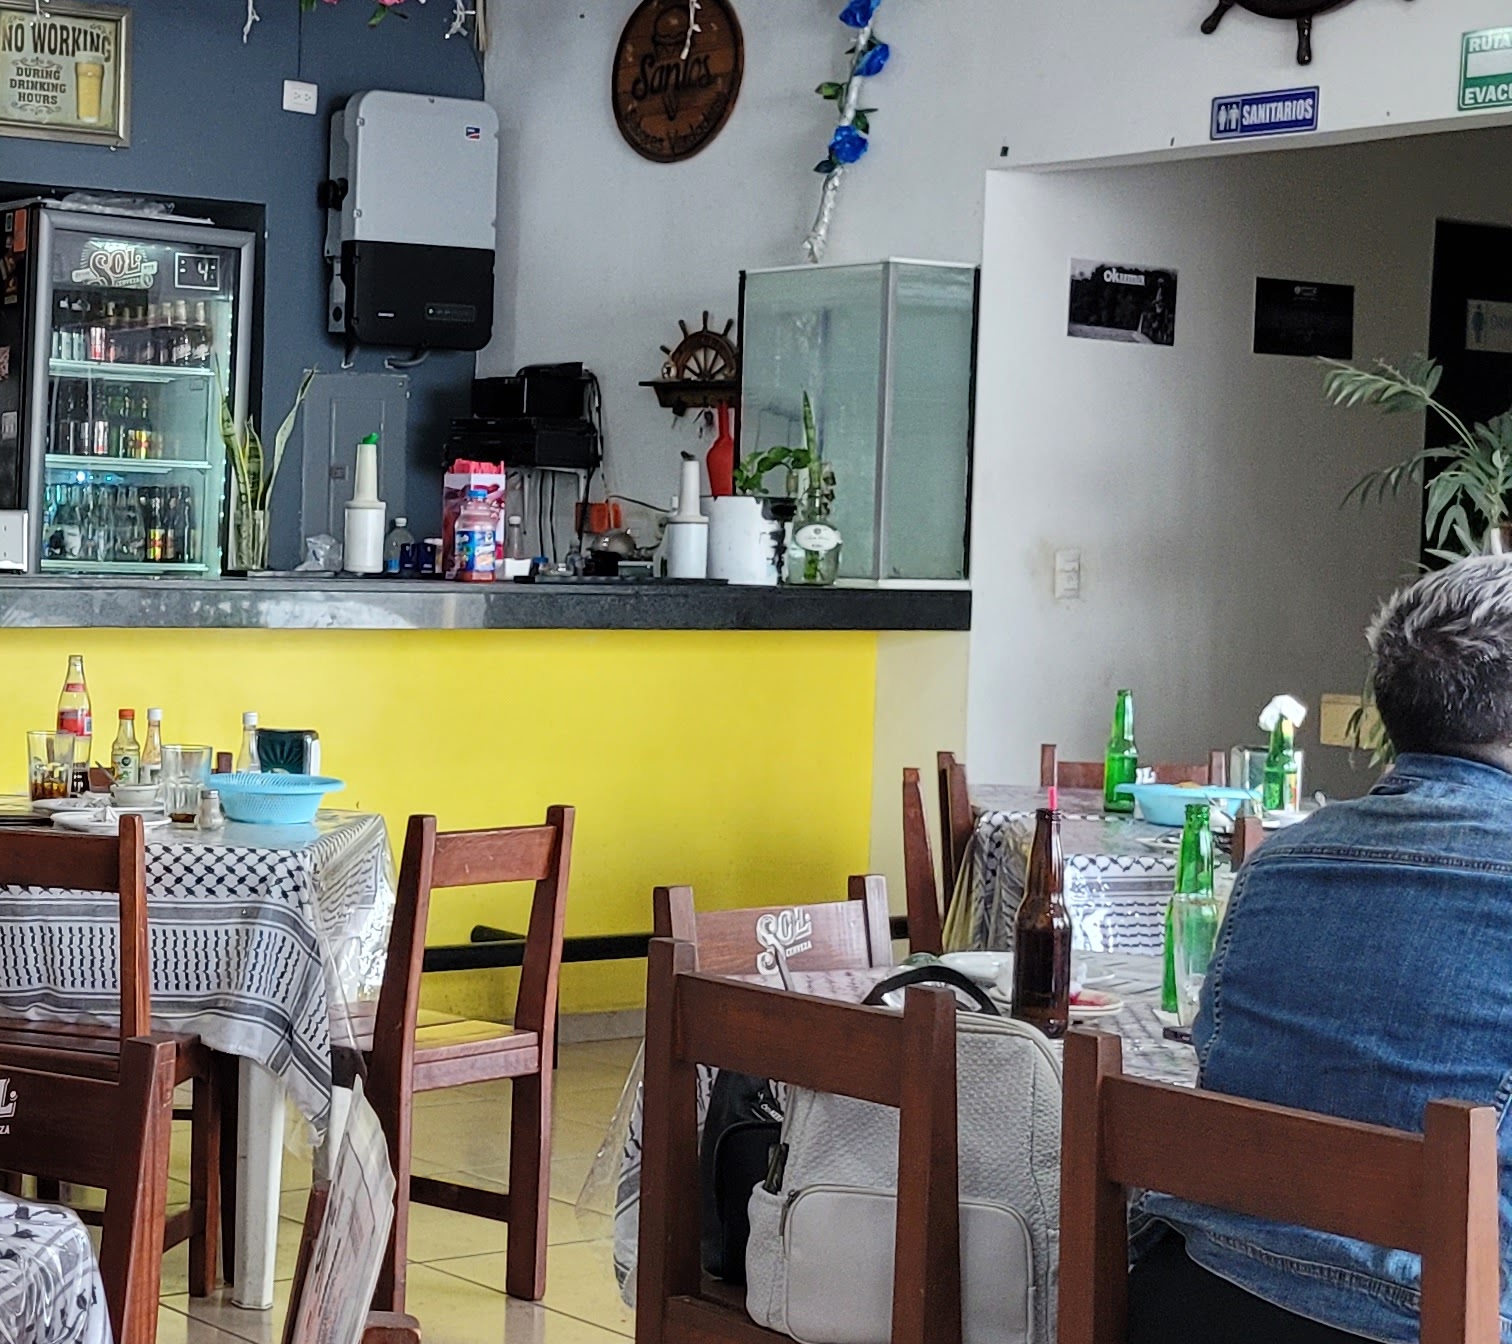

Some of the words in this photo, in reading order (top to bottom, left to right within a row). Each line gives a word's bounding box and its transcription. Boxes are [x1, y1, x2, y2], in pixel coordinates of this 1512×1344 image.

[1, 22, 25, 53] NO
[31, 22, 112, 63] WORKING
[1468, 34, 1512, 53] RUTA
[16, 66, 61, 81] DURING
[9, 78, 67, 94] DRINKING
[18, 92, 58, 105] HOURS
[1242, 98, 1313, 126] SANITARIOS
[89, 247, 143, 286] SOL
[756, 907, 813, 975] SOL
[786, 940, 813, 958] CERVEZA
